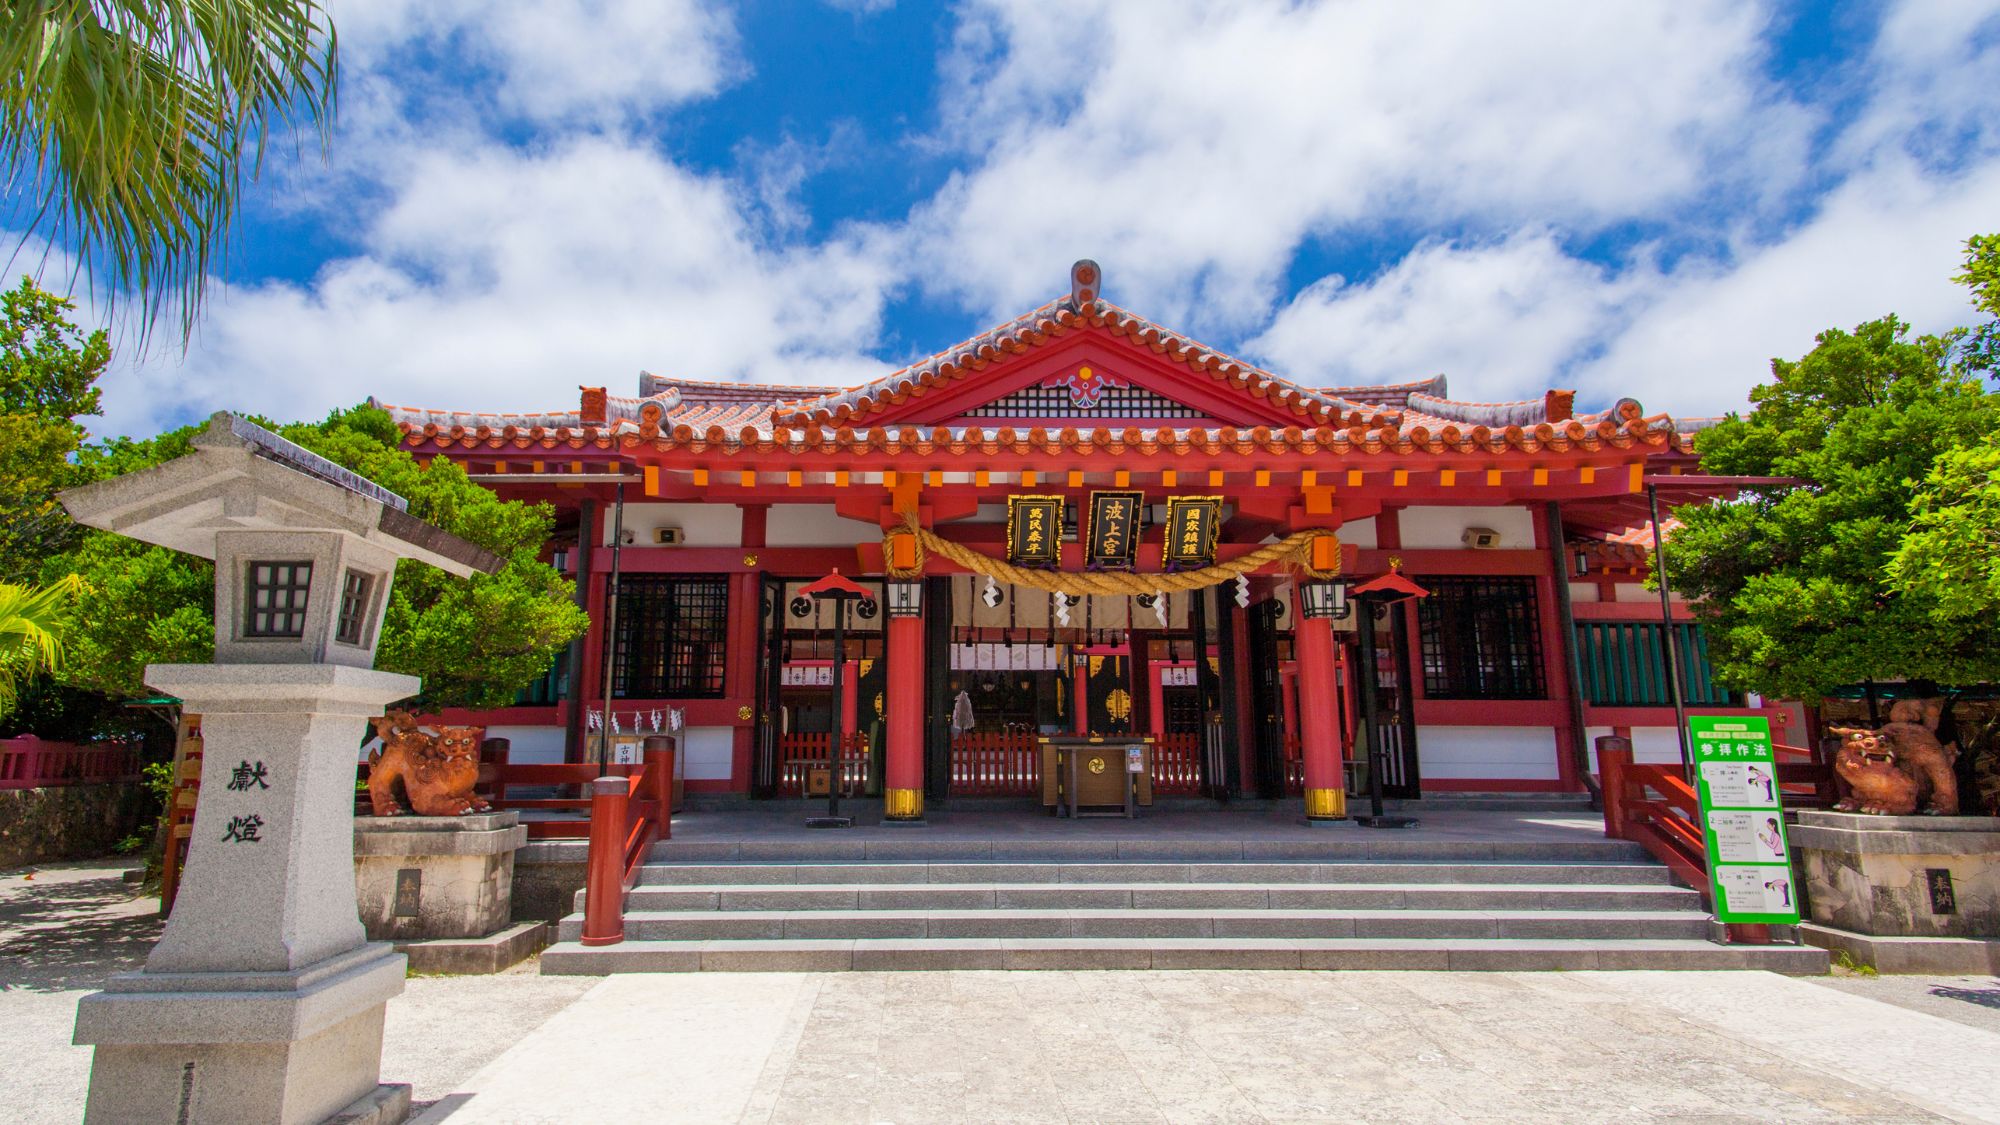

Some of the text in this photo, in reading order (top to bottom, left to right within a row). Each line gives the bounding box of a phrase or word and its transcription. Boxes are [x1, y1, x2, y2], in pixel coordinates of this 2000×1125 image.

[1026, 507, 1043, 555] 萬民泰平
[1103, 501, 1124, 555] 波上宮
[1701, 743, 1767, 756] 参拝作法
